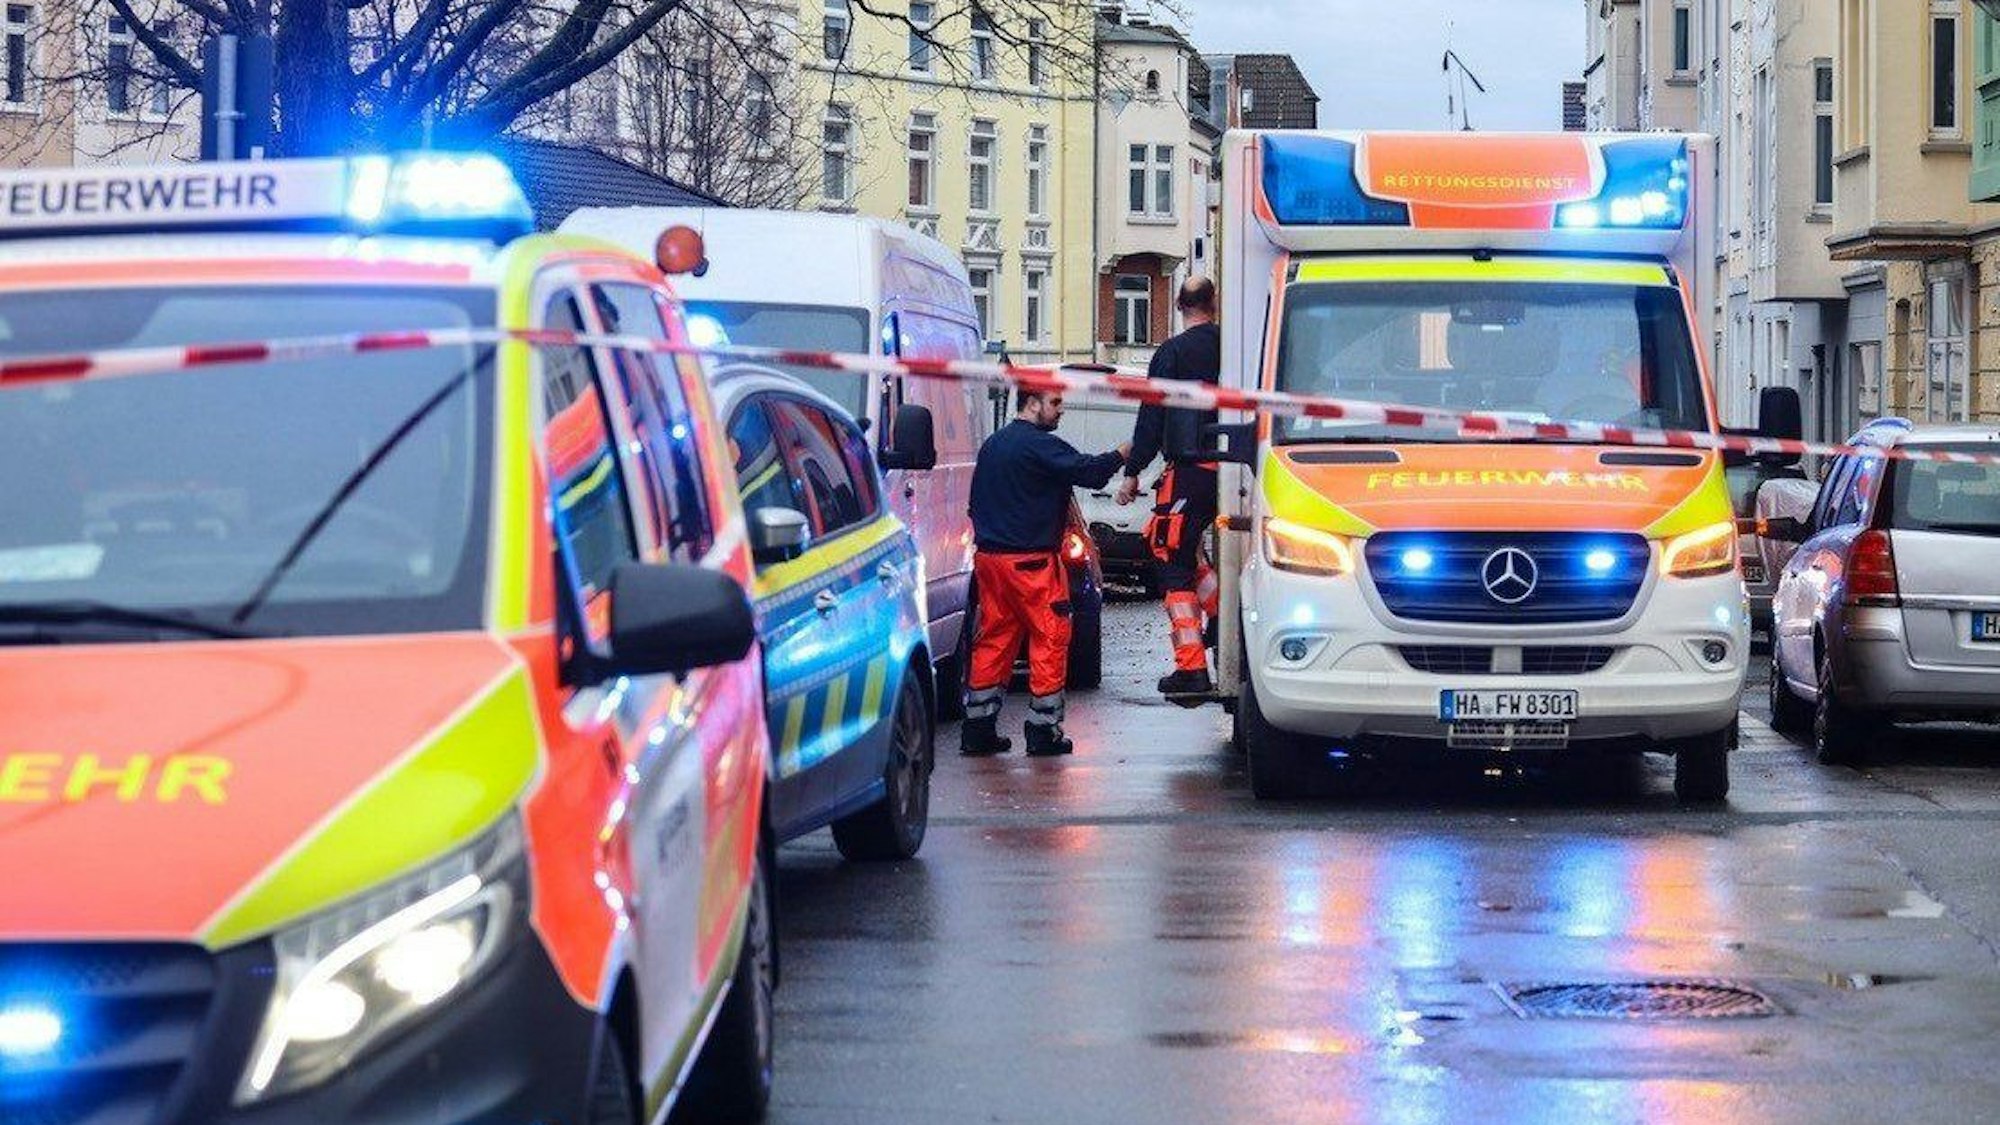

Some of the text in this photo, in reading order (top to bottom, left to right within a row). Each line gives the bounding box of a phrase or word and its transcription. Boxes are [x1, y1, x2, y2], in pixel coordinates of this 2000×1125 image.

[1383, 174, 1576, 190] RETTUNGSDIENST
[0, 174, 278, 215] EUERWEHR
[1367, 469, 1649, 492] FEUERWEHR
[1456, 694, 1574, 715] HA FW 8301
